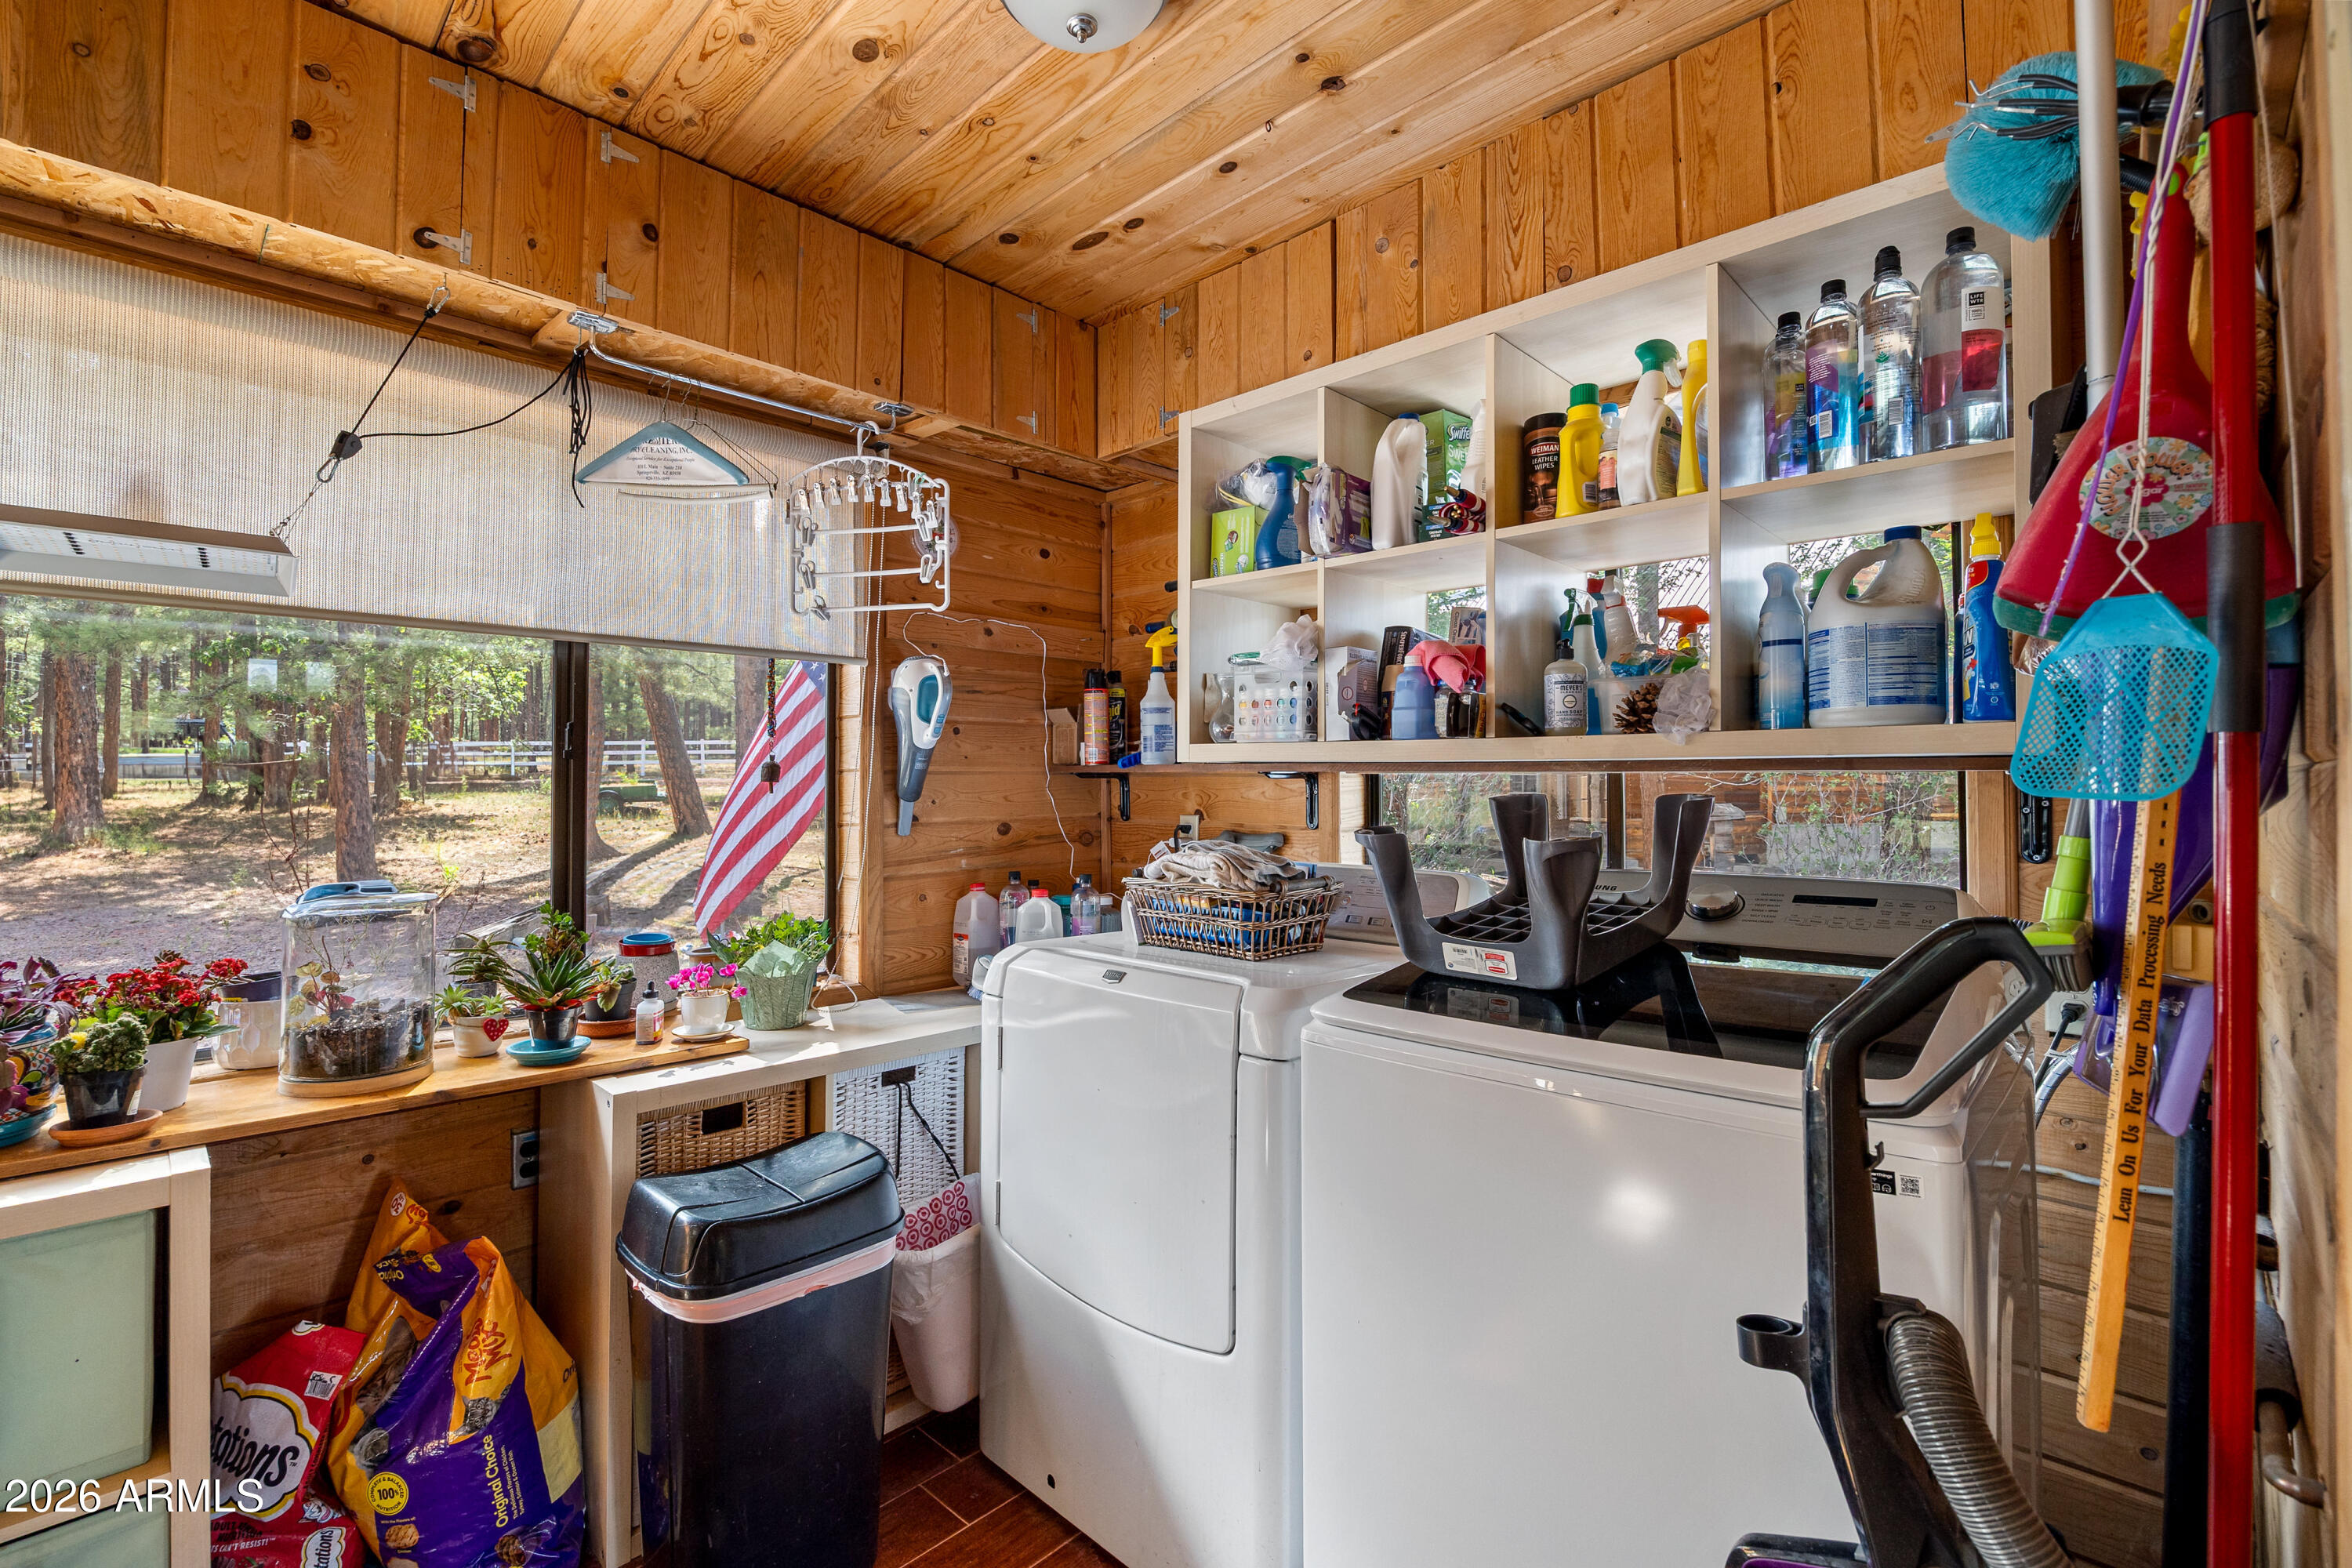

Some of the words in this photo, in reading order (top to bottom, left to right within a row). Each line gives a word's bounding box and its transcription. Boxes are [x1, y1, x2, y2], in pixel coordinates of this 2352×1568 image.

[1448, 426, 1471, 441] Swiffe
[1530, 442, 1559, 455] WEIMAN
[1531, 456, 1559, 465] LEATHER
[2146, 862, 2167, 905] Needs
[2137, 915, 2165, 989] Processing
[2133, 999, 2153, 1033] Data
[2128, 1043, 2148, 1078] Your
[2124, 1088, 2143, 1116] For
[2121, 1124, 2140, 1144] Us
[2118, 1155, 2136, 1177] On
[2112, 1187, 2133, 1224] Lean
[463, 1317, 492, 1387] Meow
[481, 1322, 513, 1371] Mix
[210, 1416, 300, 1487] tations
[481, 1434, 499, 1479] Choice
[369, 1477, 382, 1503] COMPLETE
[387, 1477, 405, 1499] BALANCED
[376, 1501, 402, 1512] NUTRITION
[377, 1487, 400, 1501] 100%
[487, 1477, 509, 1528] Original
[220, 1542, 238, 1552] CAN'T
[239, 1538, 269, 1549] RESIST!
[314, 1530, 334, 1568] tations
